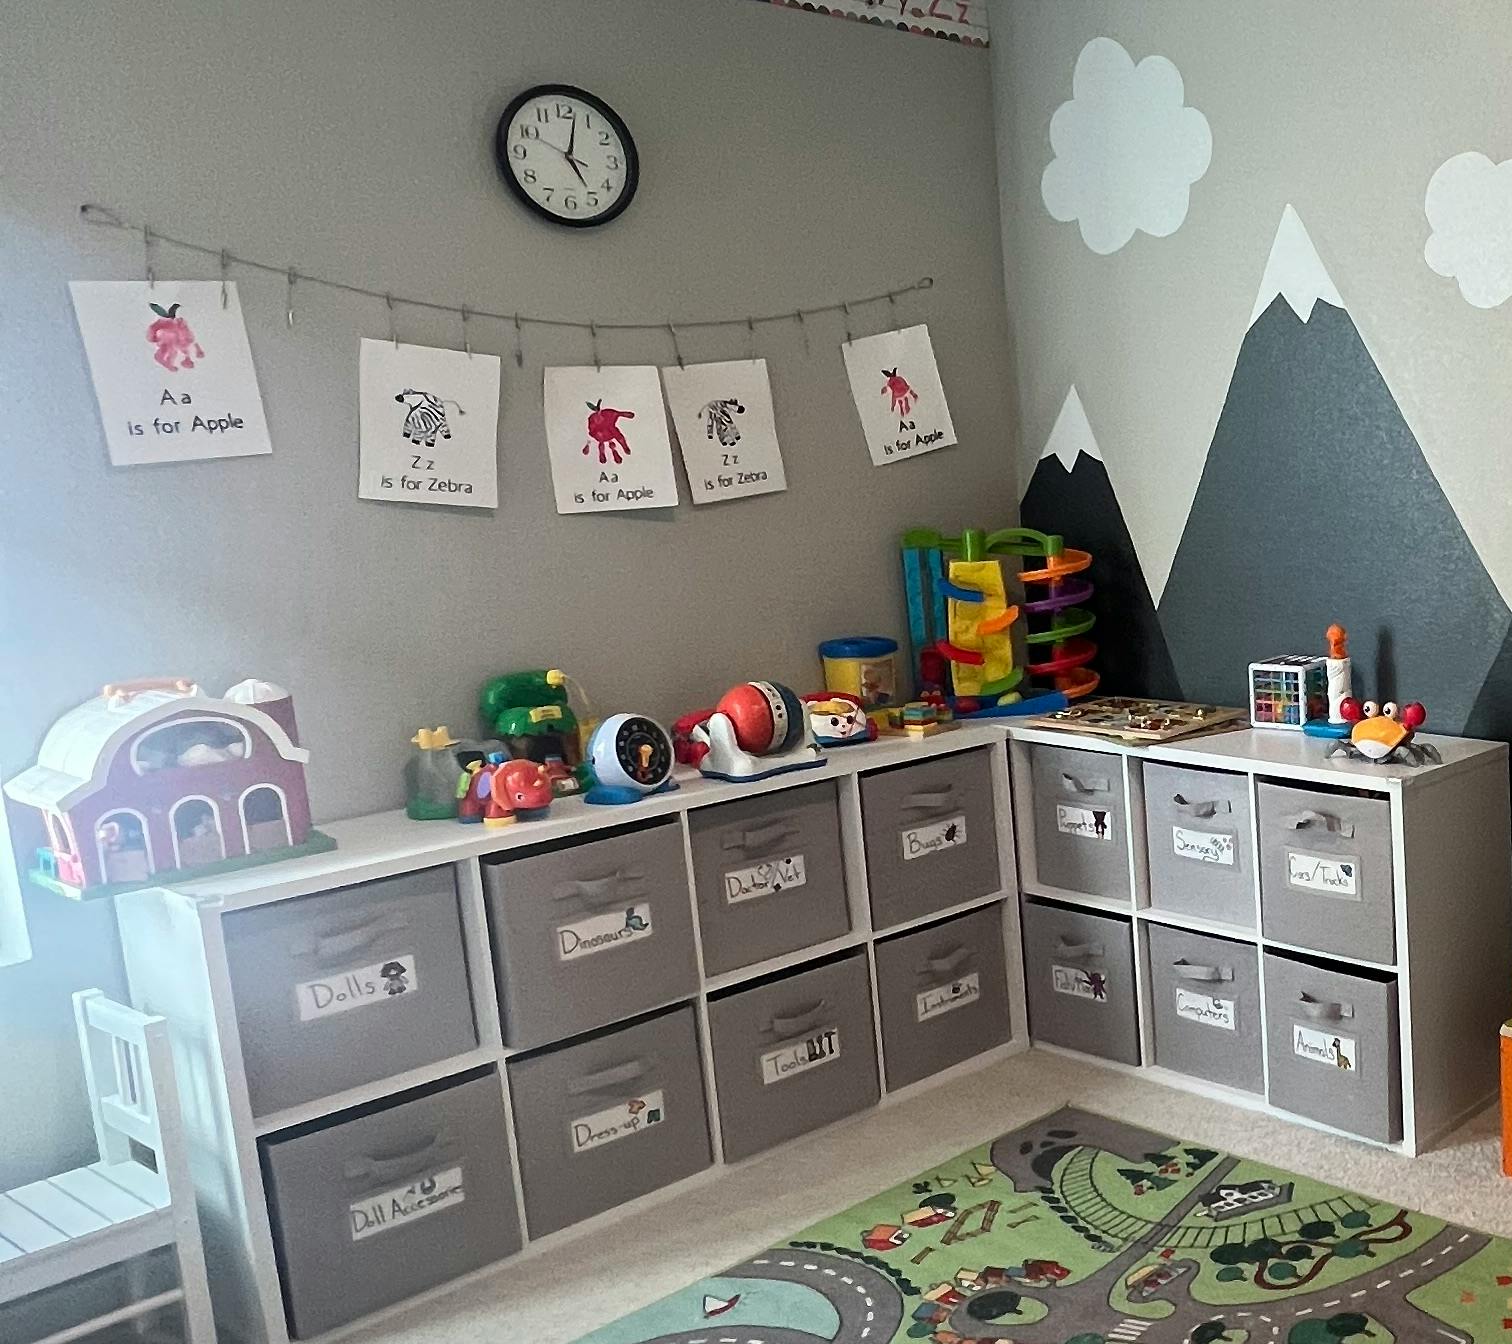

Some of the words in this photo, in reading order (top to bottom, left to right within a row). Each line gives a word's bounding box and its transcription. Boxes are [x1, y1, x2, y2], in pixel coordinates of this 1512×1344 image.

[536, 107, 549, 124] 11
[556, 103, 573, 120] 12
[585, 114, 591, 130] 1
[519, 124, 539, 140] 10
[598, 131, 610, 146] 2
[513, 144, 527, 160] 9
[606, 155, 619, 171] 3
[523, 168, 537, 184] 8
[600, 178, 613, 192] 4
[542, 187, 555, 202] 7
[564, 195, 578, 210] 6
[586, 190, 599, 207] 5
[127, 420, 144, 436] is
[153, 417, 181, 434] for
[191, 413, 244, 434] Apple
[380, 475, 393, 489] is
[401, 475, 423, 490] for
[427, 477, 473, 494] Zebra
[718, 474, 733, 487] for
[737, 471, 769, 485] Zebra
[574, 493, 585, 504] is
[592, 488, 610, 503] for
[616, 485, 654, 501] Apple
[308, 974, 376, 1009] Dolls
[352, 1203, 386, 1233] Doll
